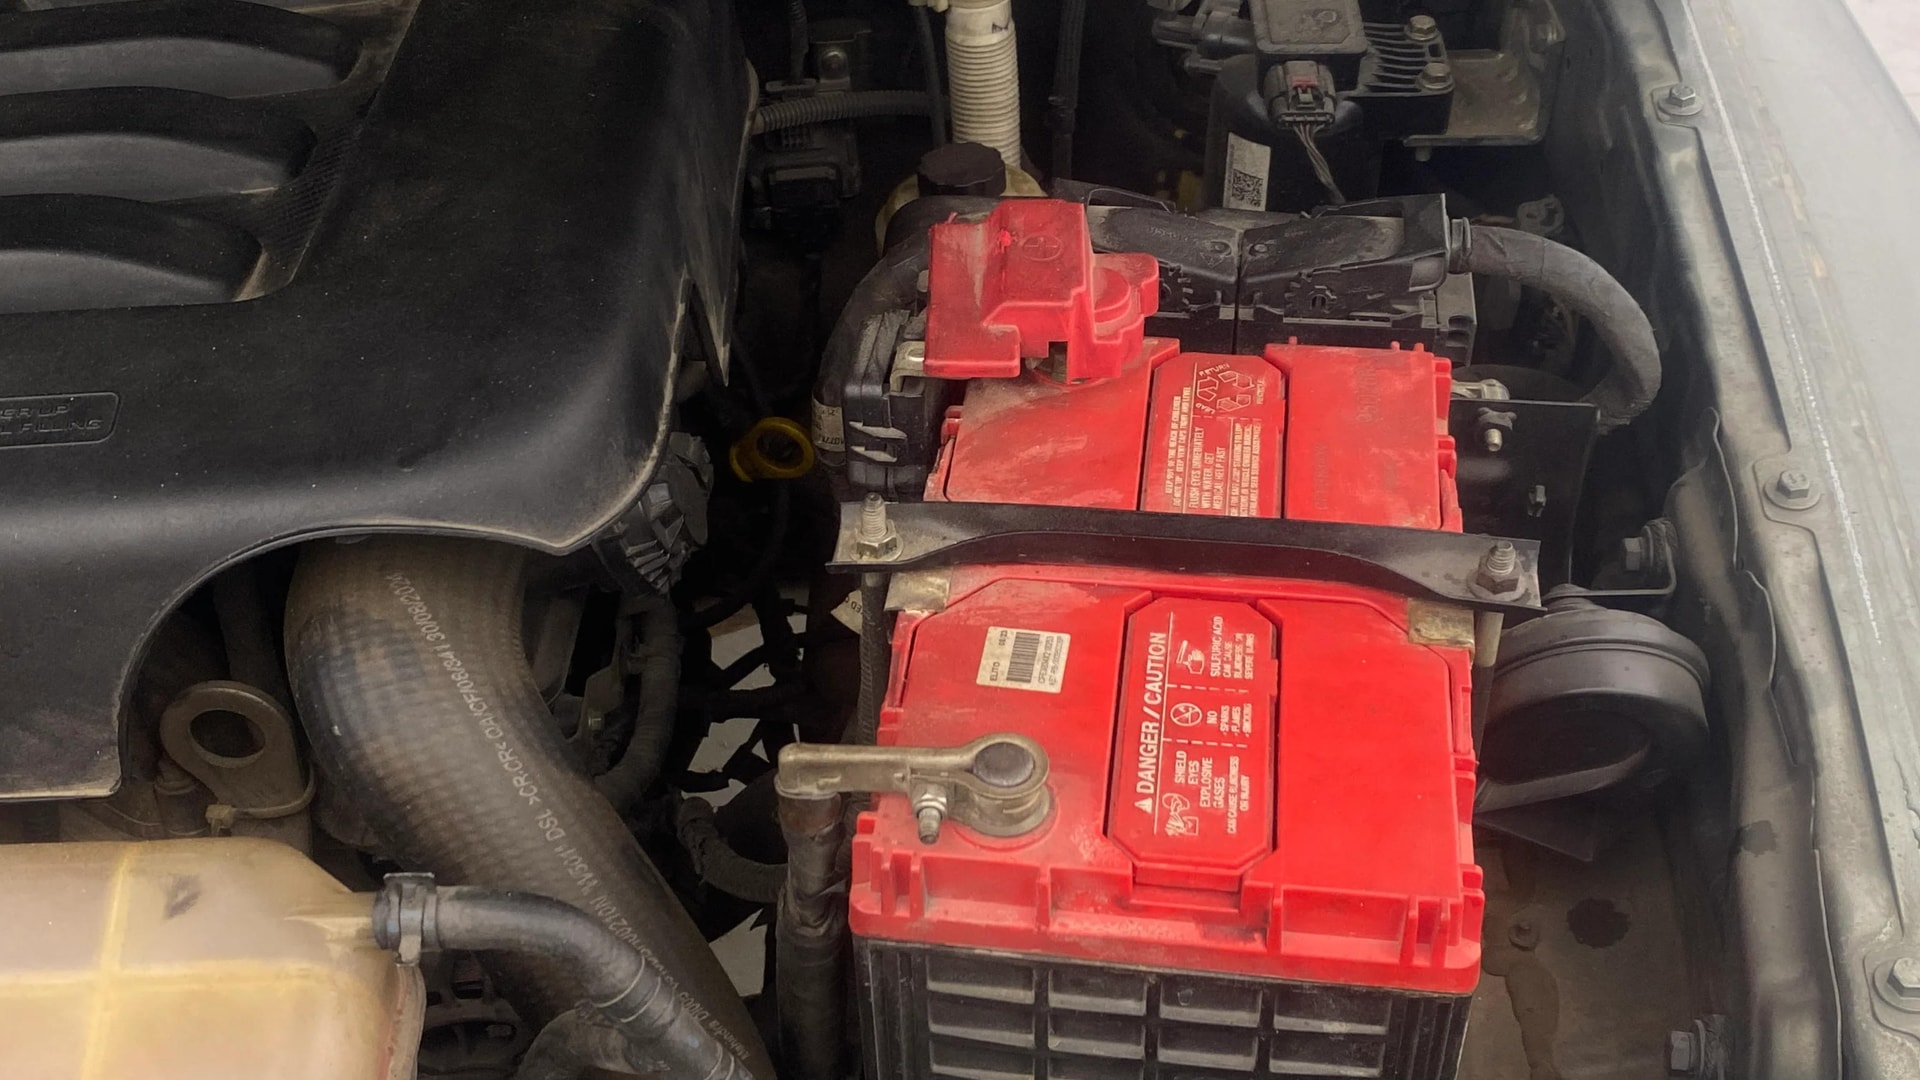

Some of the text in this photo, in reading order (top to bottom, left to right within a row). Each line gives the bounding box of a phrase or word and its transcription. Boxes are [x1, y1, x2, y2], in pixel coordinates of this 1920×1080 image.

[1195, 403, 1215, 414] LEAD
[1189, 427, 1204, 508] FLUSH EYES IMMEDIATELY
[1204, 452, 1214, 464] GET
[1212, 447, 1225, 509] MEDICAL HELP FAST
[1200, 492, 1211, 508] WITH
[1210, 616, 1223, 676] SULFURIC ACID
[1144, 632, 1166, 705] CAUTION
[1206, 711, 1217, 724] NO
[1220, 705, 1230, 731] SPARKS
[1232, 706, 1240, 732] FLAMES
[1136, 722, 1159, 794] DANGER
[1175, 751, 1187, 783] SHIELD
[1188, 760, 1199, 784] EYES
[1200, 757, 1212, 807] EXPLOSIVE
[1213, 777, 1225, 808] GASES
[534, 808, 566, 842] DSL
